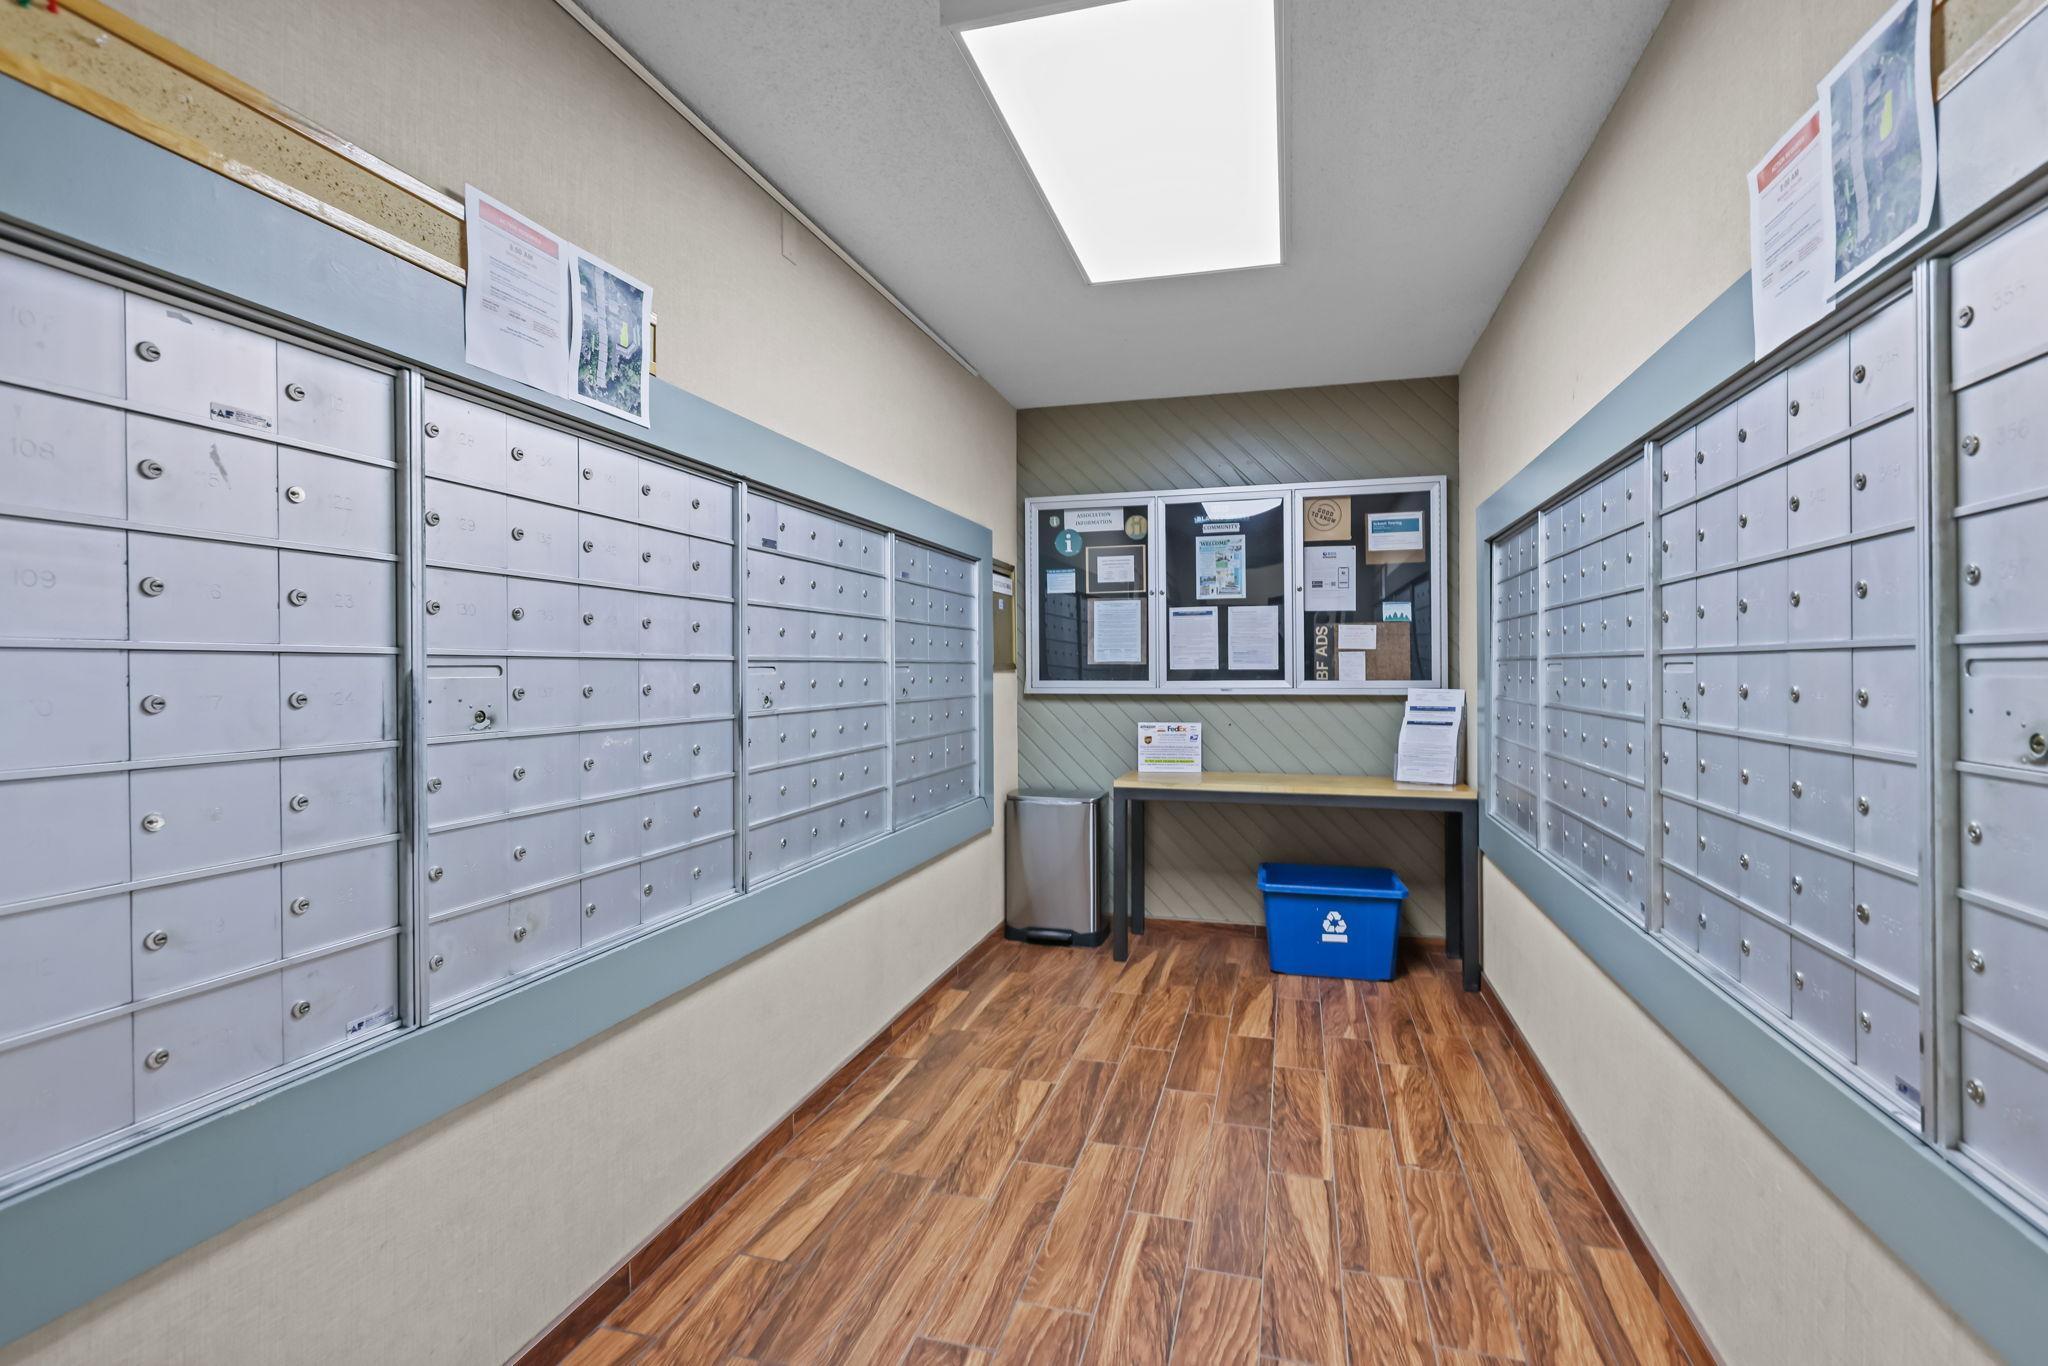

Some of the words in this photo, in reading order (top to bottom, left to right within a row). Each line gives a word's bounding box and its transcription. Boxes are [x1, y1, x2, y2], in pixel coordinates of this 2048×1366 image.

[10, 437, 56, 462] 108
[1077, 511, 1111, 519] ASSOCIATION
[1317, 507, 1334, 517] GOOD
[1319, 513, 1337, 524] KNOW
[1203, 523, 1238, 531] COMMUNITY
[12, 566, 58, 590] 109
[1315, 625, 1329, 657] ADS
[1167, 725, 1187, 733] FedEx
